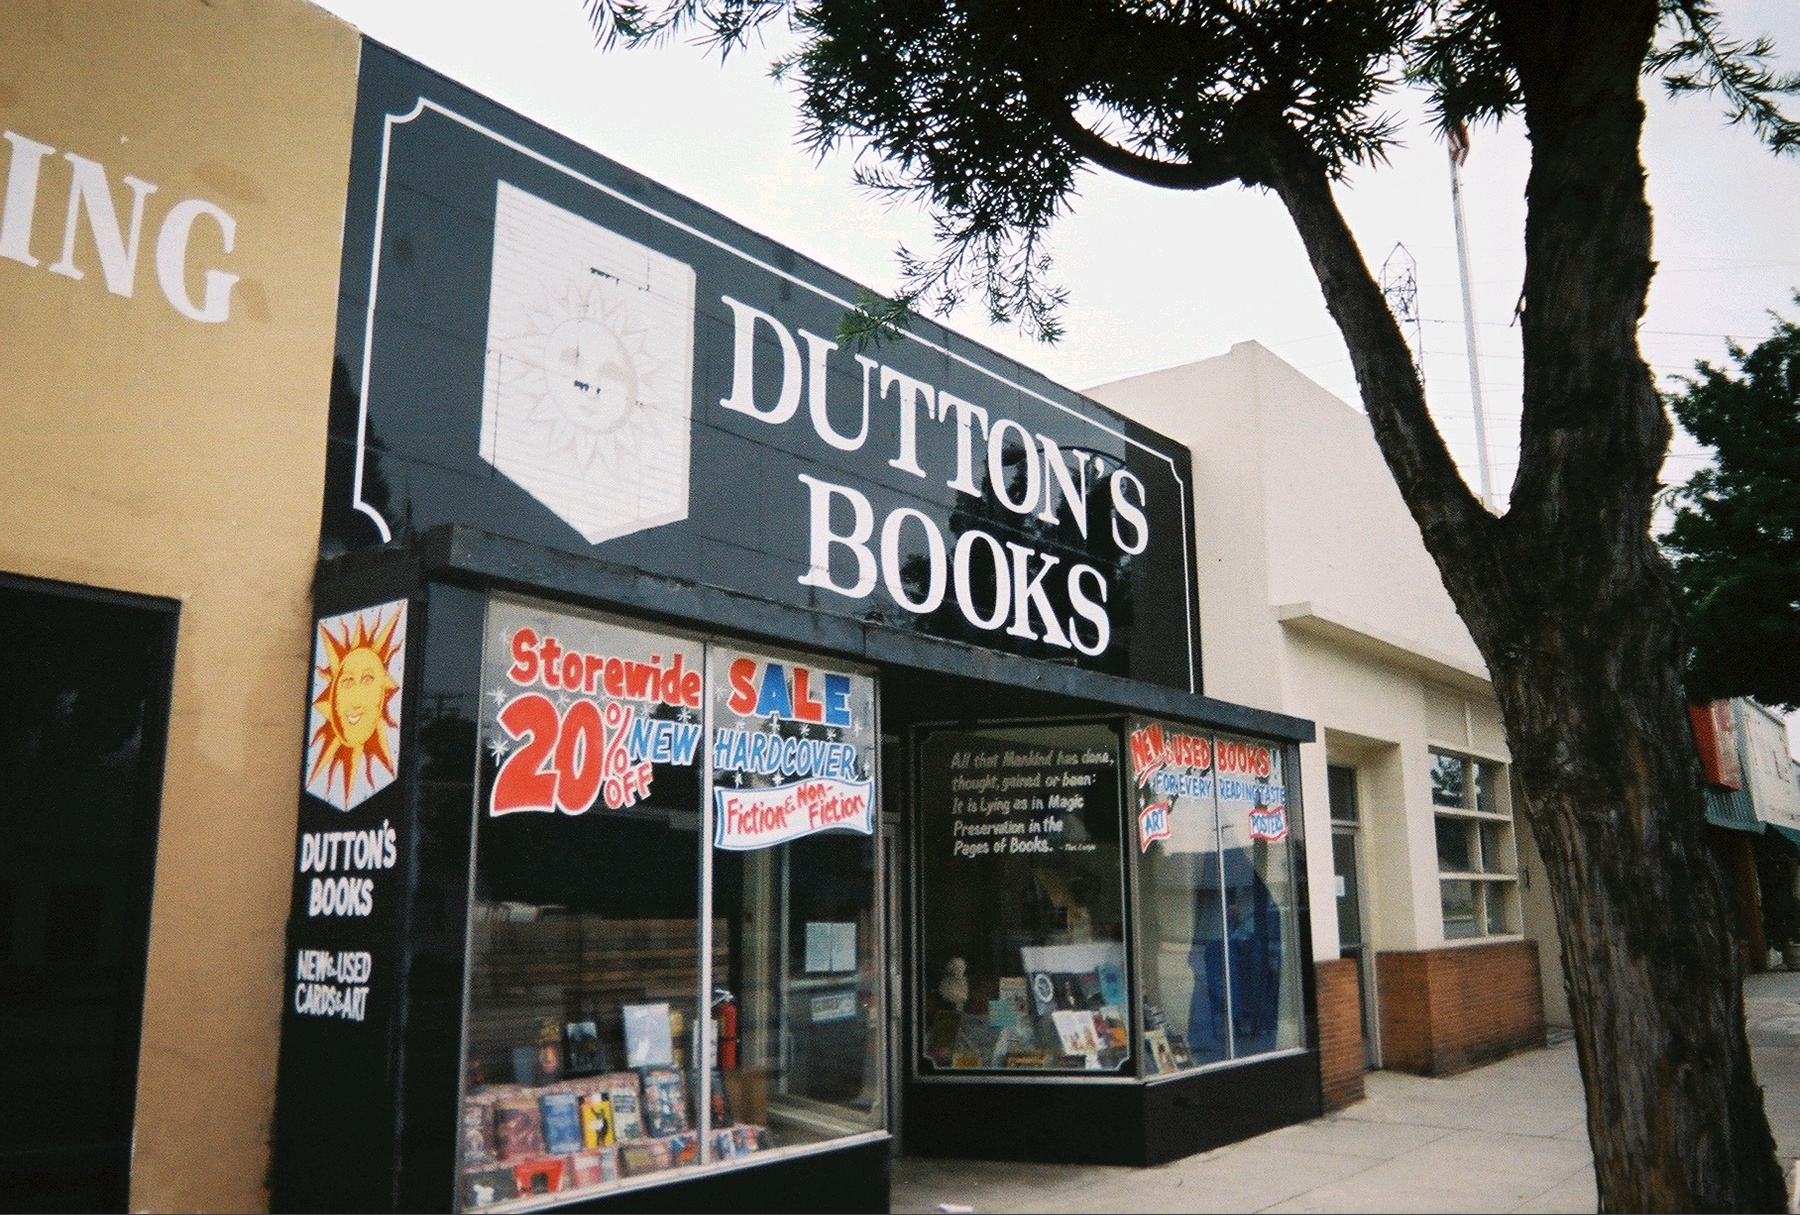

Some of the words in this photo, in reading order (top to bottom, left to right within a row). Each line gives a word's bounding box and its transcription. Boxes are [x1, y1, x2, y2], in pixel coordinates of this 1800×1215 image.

[0, 130, 240, 324] ING
[719, 295, 1149, 556] DUTTON'S
[798, 473, 1110, 657] BOOKS
[508, 627, 700, 706] Storewide
[727, 657, 852, 727] SALE
[629, 717, 699, 767] NEW
[713, 727, 858, 781] HARDCOVER
[1056, 750, 1079, 765] has
[1131, 721, 1164, 774] NEW
[1172, 733, 1212, 769] USED
[603, 763, 654, 810] OFF
[1045, 776, 1060, 787] or
[1155, 771, 1178, 793] FOR
[1179, 773, 1212, 798] EVERY
[727, 798, 787, 835] Fiction
[808, 792, 866, 830] Fiction
[1013, 798, 1028, 810] as
[1032, 795, 1044, 810] in
[1048, 794, 1085, 812] Magic
[1144, 810, 1165, 833] ART
[953, 820, 1025, 837] Preservation
[1029, 819, 1041, 833] in
[1043, 815, 1064, 832] the
[300, 819, 397, 873] DUTTON'S
[953, 840, 990, 858] Pages
[993, 837, 1007, 853] of
[308, 877, 374, 917] BOOKS
